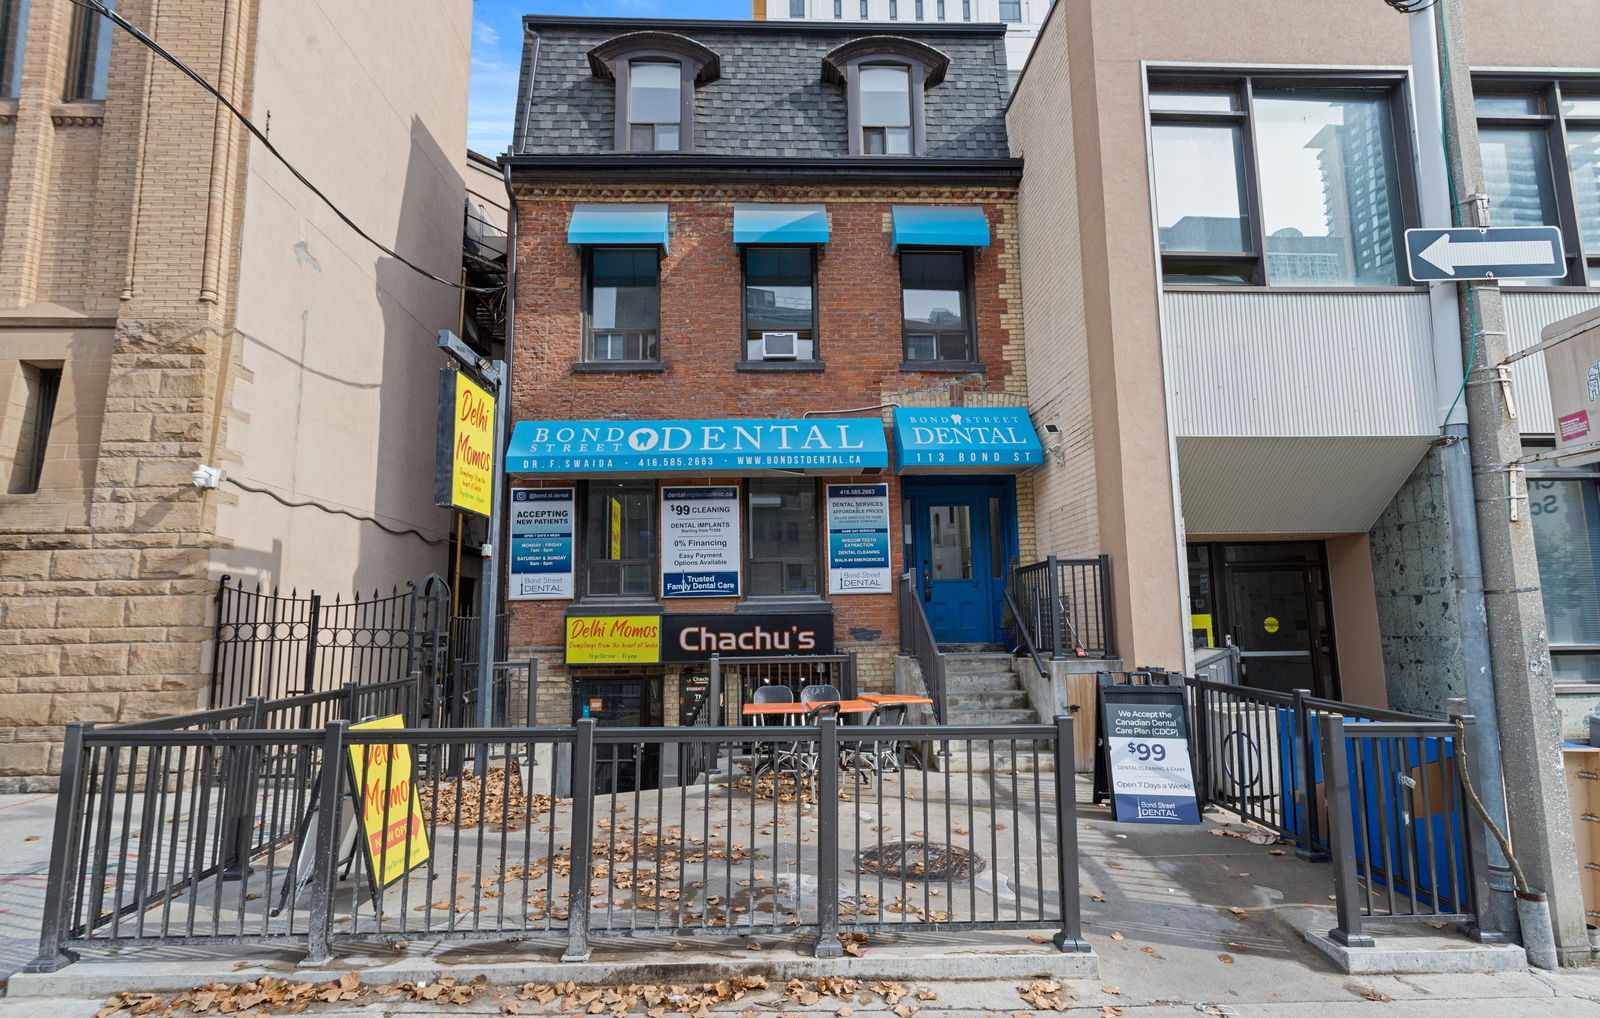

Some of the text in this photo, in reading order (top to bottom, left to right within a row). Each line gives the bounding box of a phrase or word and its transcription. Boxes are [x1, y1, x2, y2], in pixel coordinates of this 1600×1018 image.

[460, 389, 490, 433] Delhi
[910, 416, 1018, 424] BOND STREET
[533, 427, 625, 442] BOND
[658, 423, 864, 451] DENTAL
[911, 427, 1026, 444] DENTAL
[456, 431, 490, 472] Momos
[529, 443, 622, 453] STREET
[737, 455, 861, 465] WWW.BONDSTDENTAL.CA
[916, 451, 1031, 462] 113 BOND ST
[516, 510, 568, 518] ACCEPTING
[670, 504, 730, 516] $99 CLEANING
[688, 539, 728, 548] Financing
[687, 575, 715, 583] Trusted
[524, 585, 563, 593] DENTAL
[692, 582, 716, 590] Dental
[570, 619, 658, 640] Delhi Momos
[679, 625, 816, 651] Chachu's
[1132, 710, 1158, 720] Accept
[1115, 718, 1177, 727] Canadian Dental
[1115, 727, 1179, 737] Care Plan (CDCP)
[1127, 741, 1167, 761] $99
[1116, 781, 1137, 789] Open
[1143, 781, 1161, 790] Days
[363, 777, 411, 822] Momo
[1157, 801, 1177, 809] Street
[1141, 808, 1178, 817] DENTAL
[375, 823, 413, 848] NW OPE
